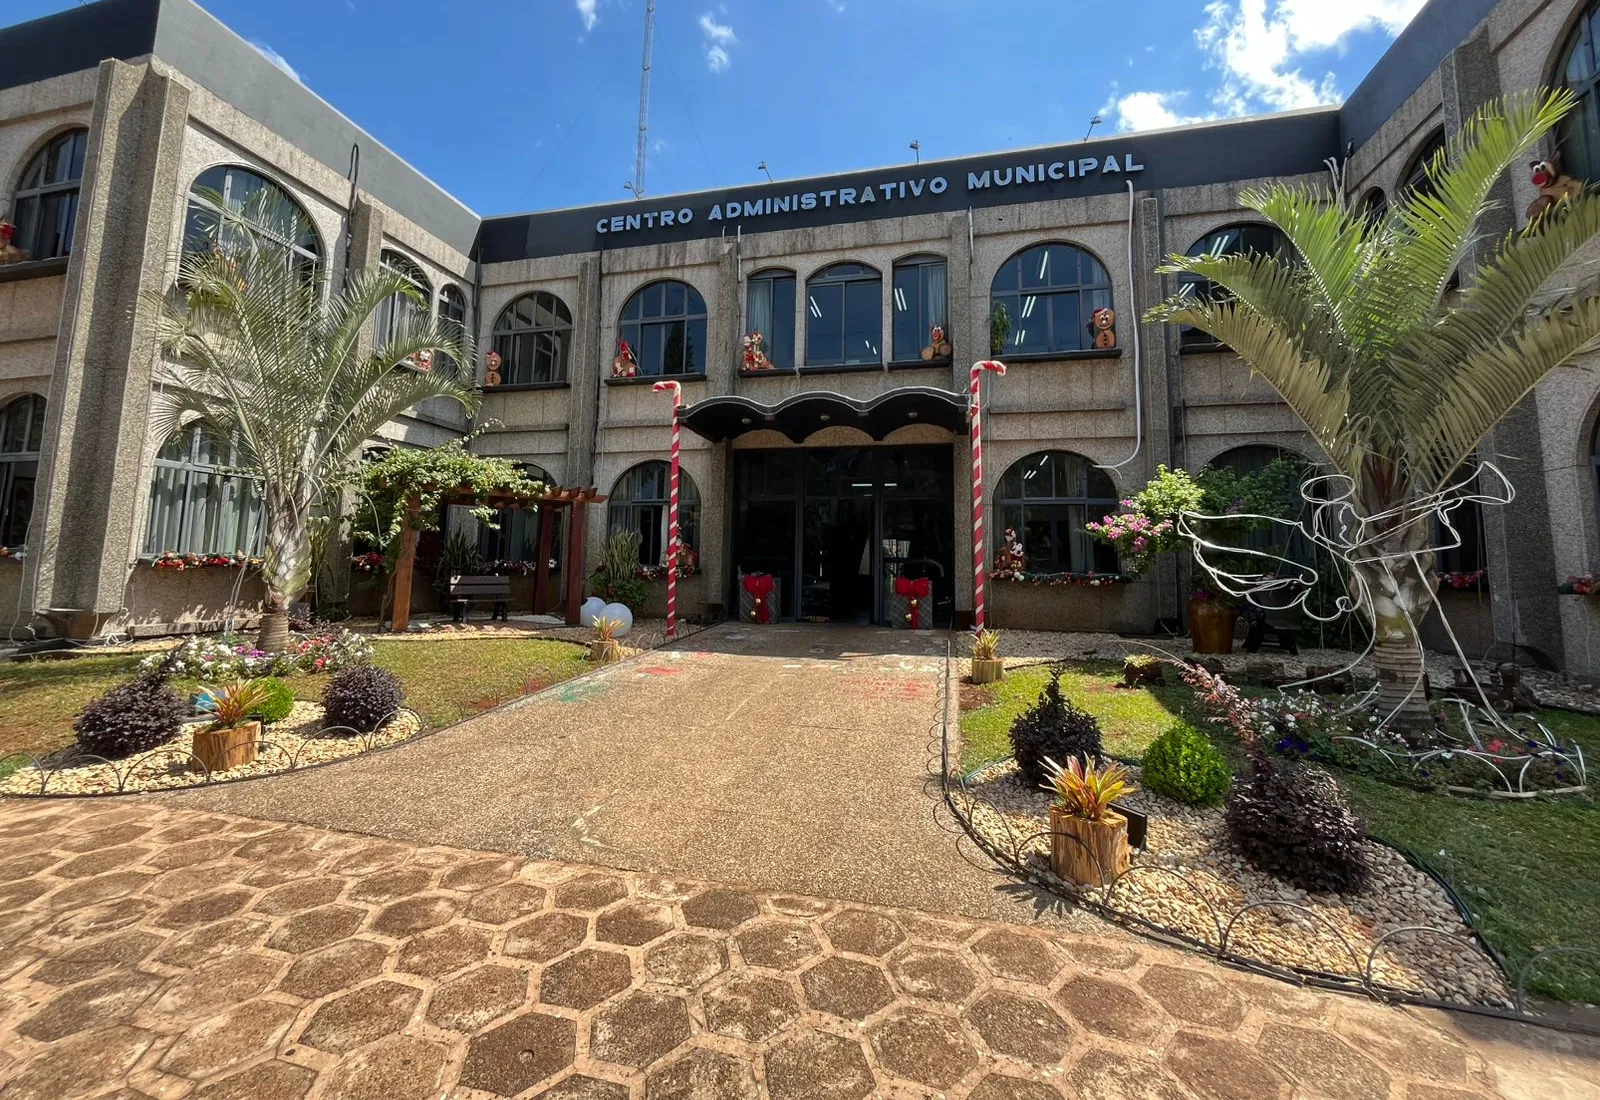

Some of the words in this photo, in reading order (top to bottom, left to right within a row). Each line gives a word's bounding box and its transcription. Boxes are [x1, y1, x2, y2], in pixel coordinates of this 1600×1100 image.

[596, 208, 694, 234] CENTRO
[708, 176, 948, 221] ADMINISTRATIVO
[967, 153, 1145, 190] MUNICIPAL
